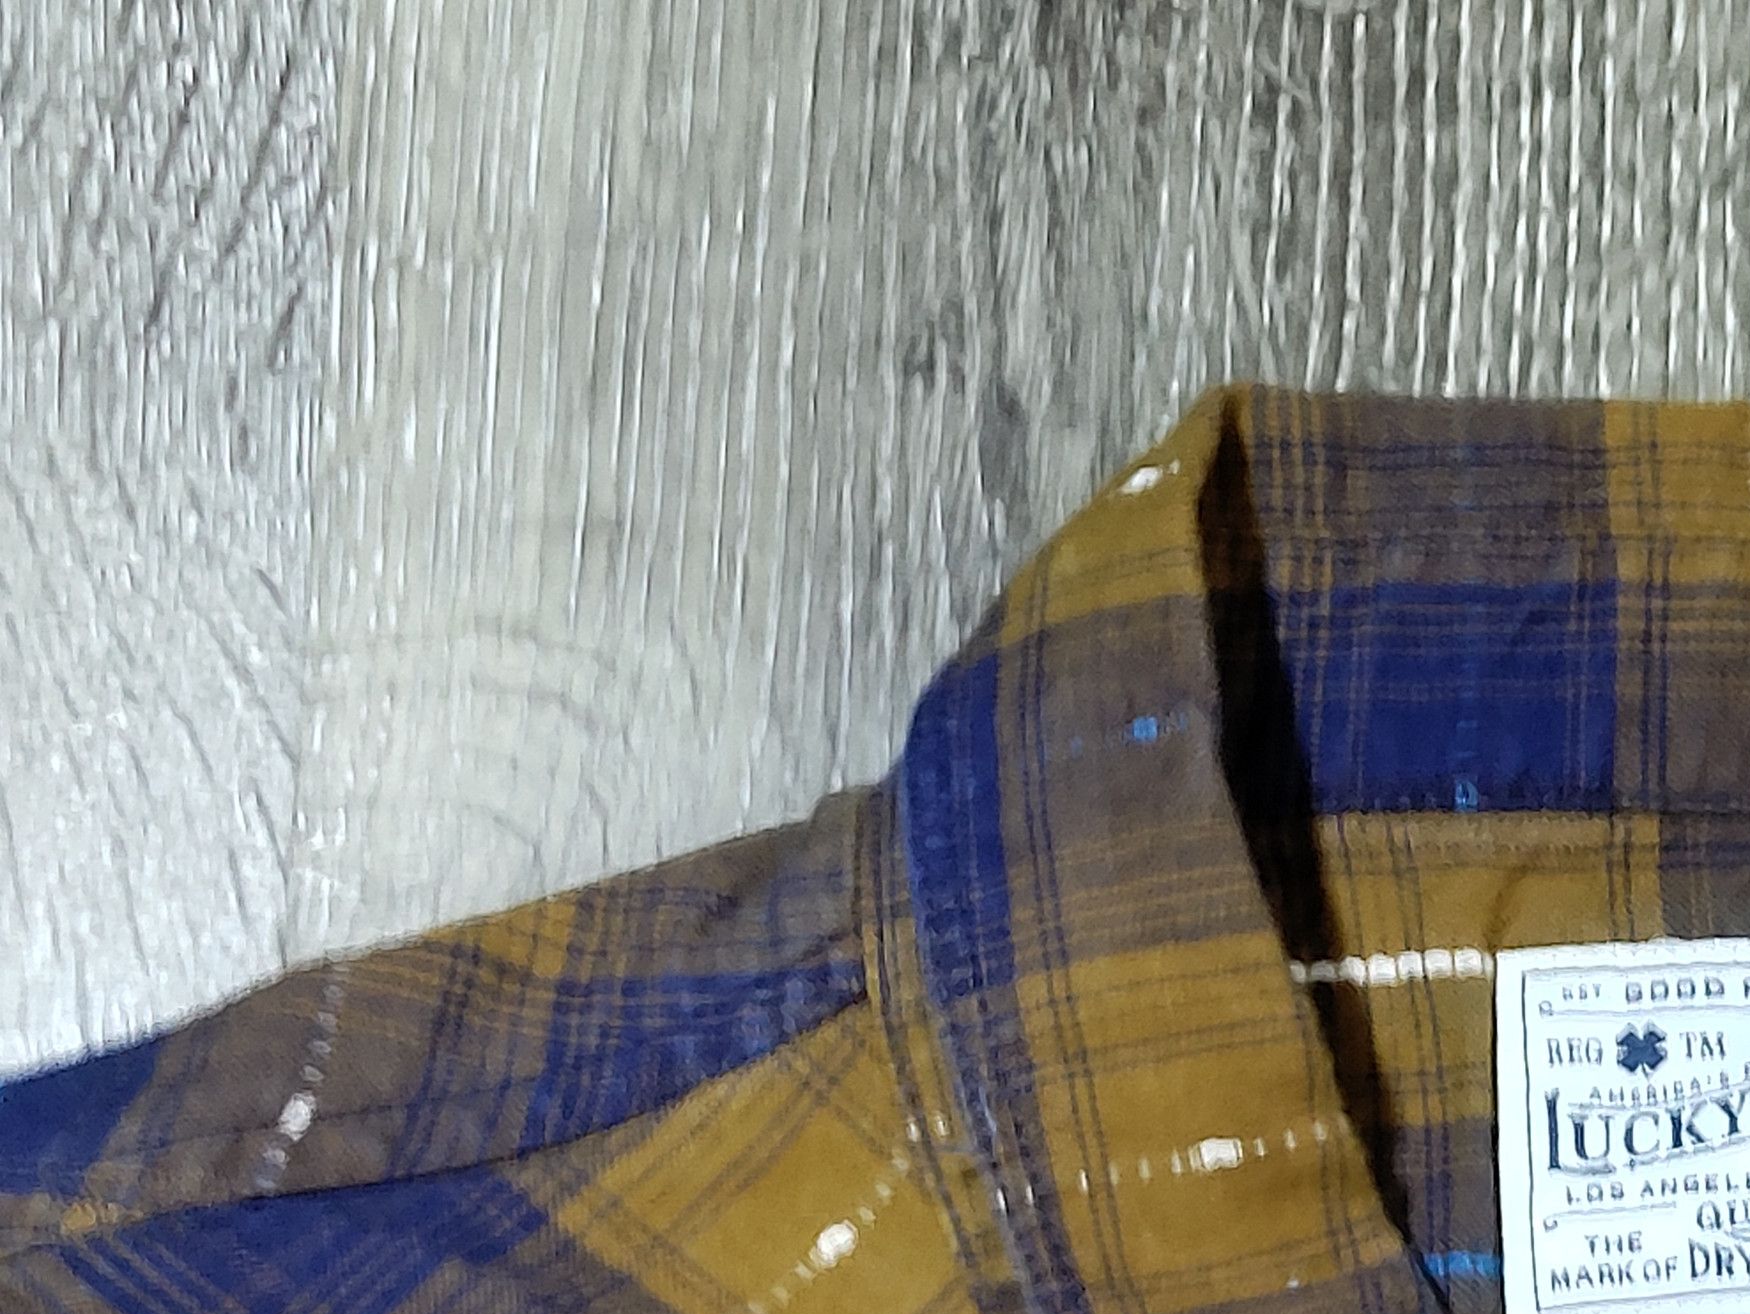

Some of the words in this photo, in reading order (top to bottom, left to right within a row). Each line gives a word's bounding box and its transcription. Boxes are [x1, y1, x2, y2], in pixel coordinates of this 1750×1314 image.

[1625, 976, 1725, 1004] GOOD
[1547, 1037, 1603, 1067] REG
[1679, 1031, 1726, 1060] TM
[1566, 1181, 1624, 1206] LOS
[1584, 1230, 1642, 1257] THE
[1551, 1260, 1634, 1292] MARK
[1643, 1256, 1677, 1282] OF
